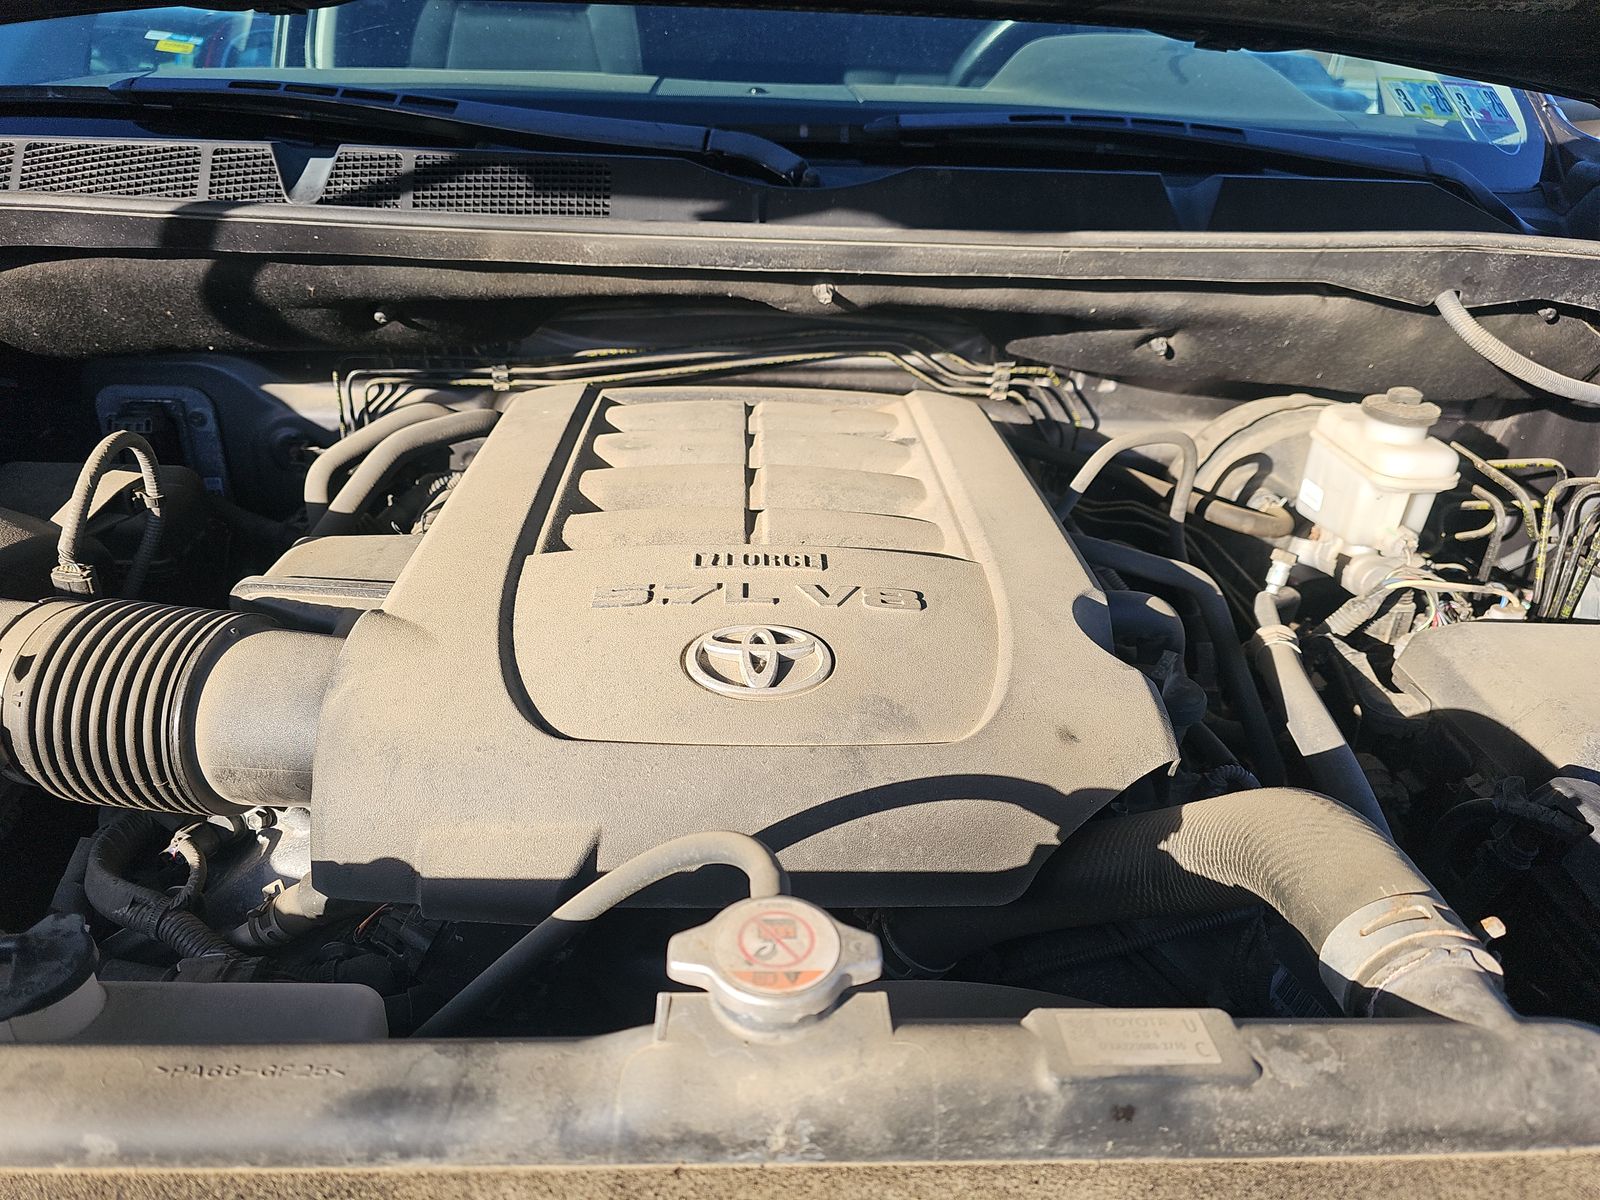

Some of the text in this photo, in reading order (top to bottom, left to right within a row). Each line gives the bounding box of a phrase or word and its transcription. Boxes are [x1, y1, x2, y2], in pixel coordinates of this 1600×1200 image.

[1395, 88, 1415, 112] 3
[1456, 93, 1473, 116] 3
[590, 582, 928, 611] 5.7L V8
[1103, 1017, 1198, 1033] TOYOTA U
[1194, 1041, 1211, 1057] C
